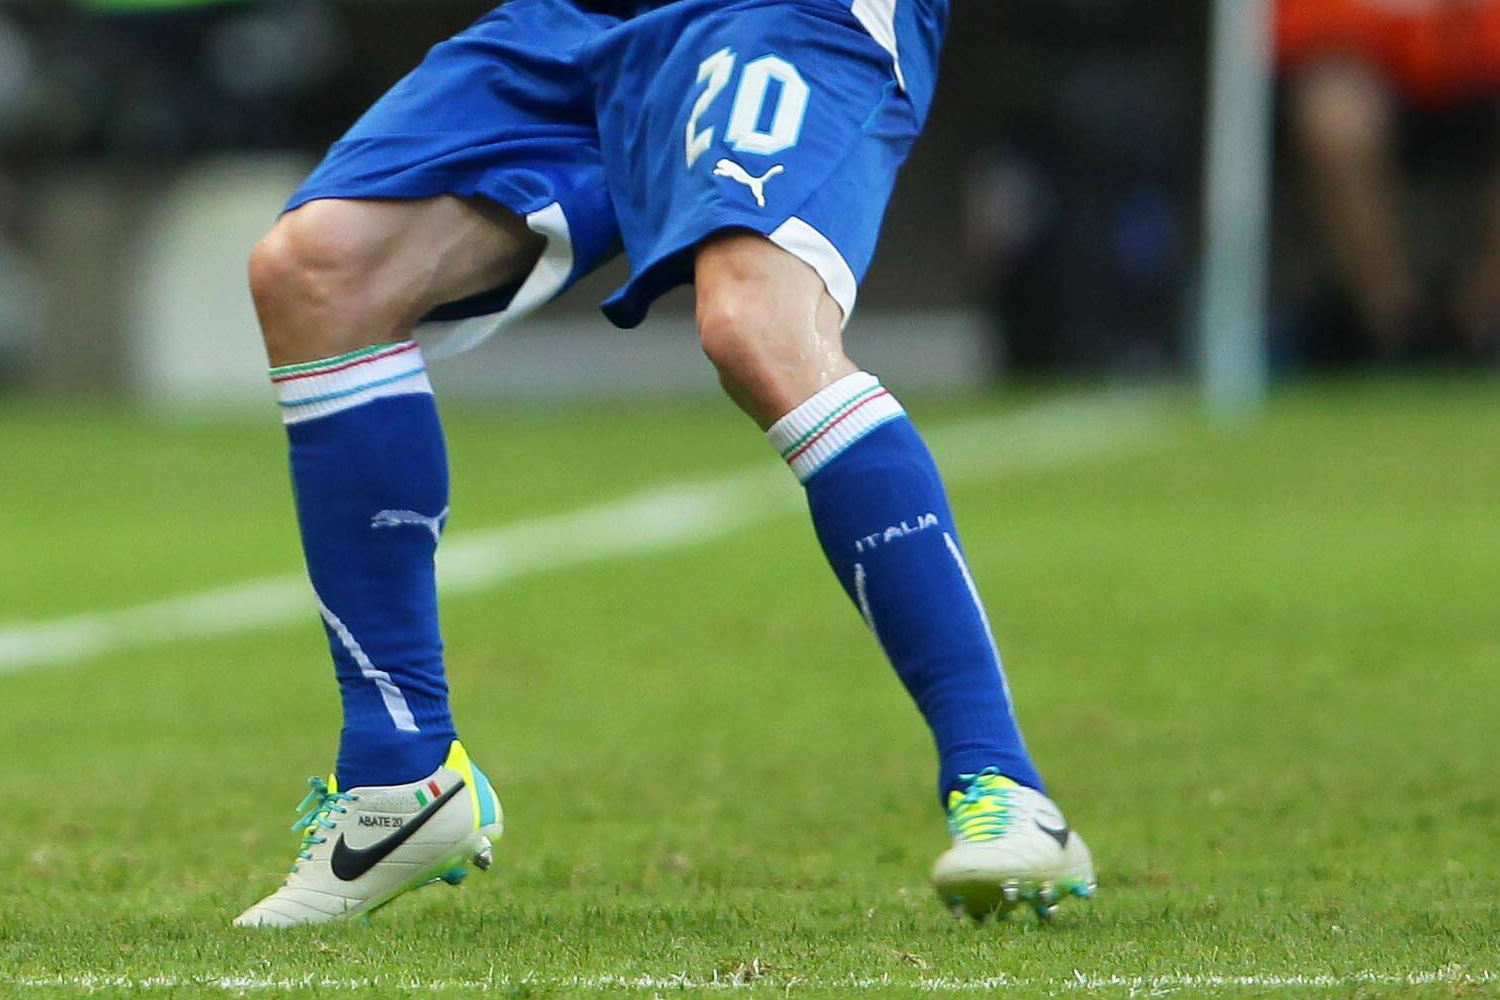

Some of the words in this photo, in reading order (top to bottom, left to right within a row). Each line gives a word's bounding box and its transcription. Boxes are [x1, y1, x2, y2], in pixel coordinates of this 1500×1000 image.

[685, 46, 812, 169] 20
[854, 511, 938, 553] ITALIA
[358, 815, 391, 828] ABATE
[392, 816, 404, 828] 20
